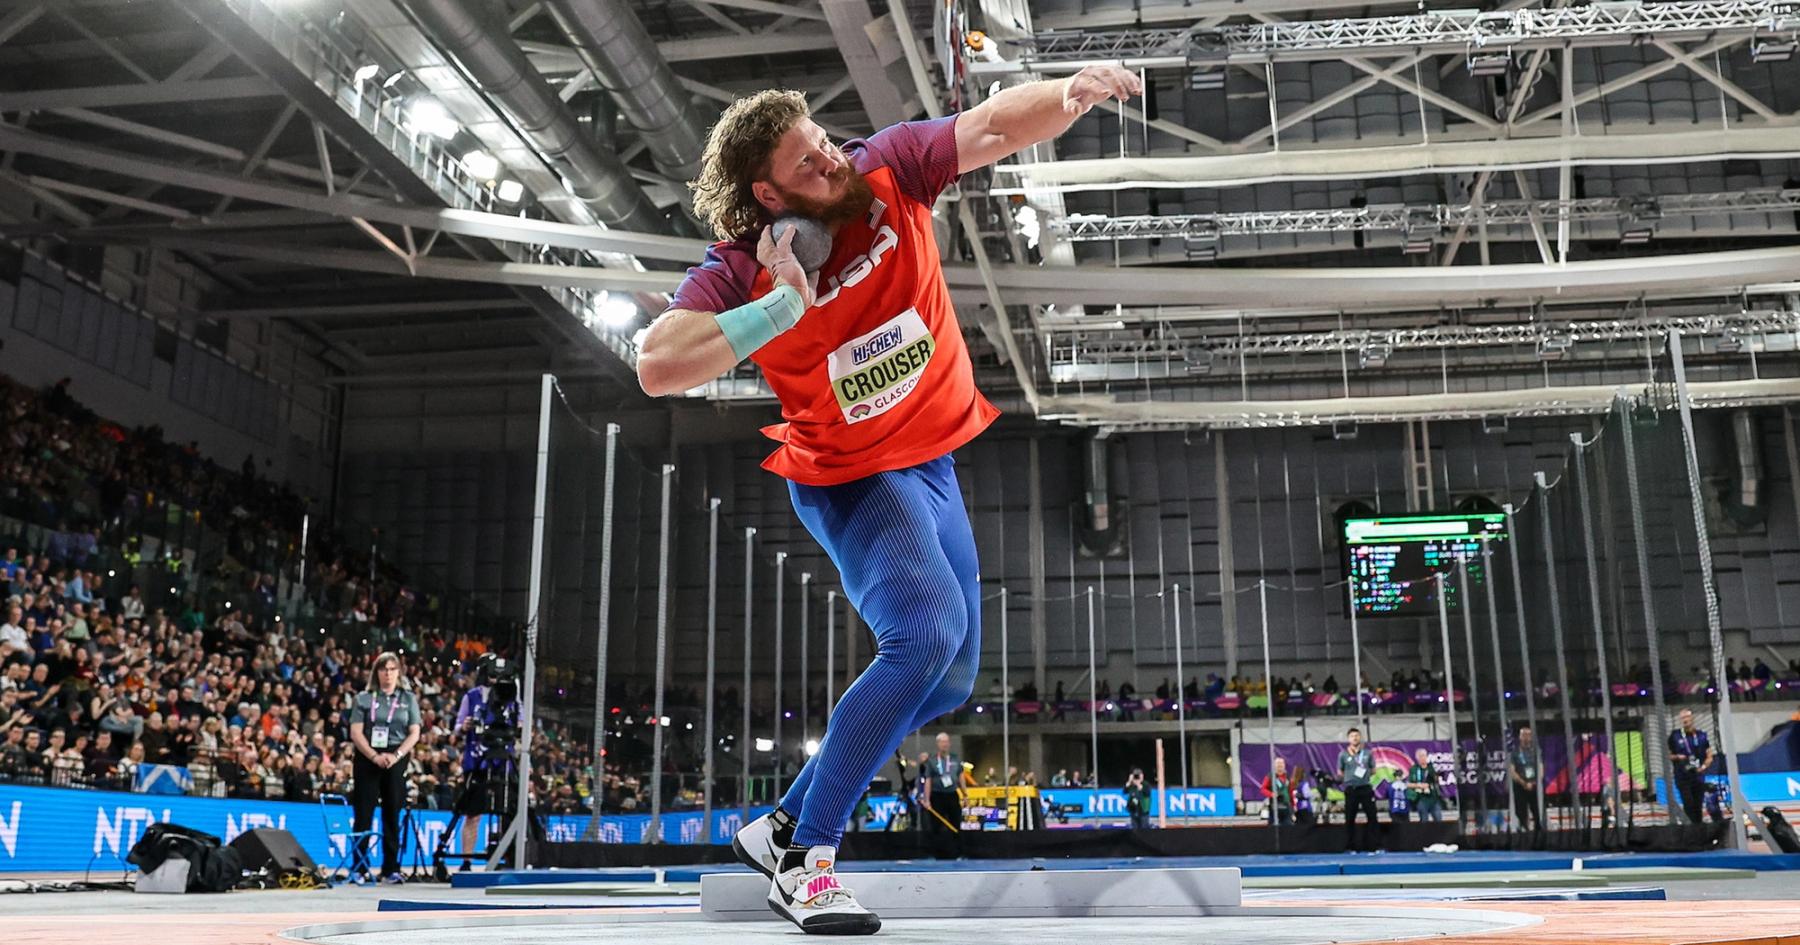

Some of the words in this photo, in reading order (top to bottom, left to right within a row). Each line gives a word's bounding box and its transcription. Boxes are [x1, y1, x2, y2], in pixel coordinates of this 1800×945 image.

[813, 225, 899, 307] USA
[851, 325, 902, 365] HI-CHEW
[841, 340, 931, 401] CROUSER
[1438, 770, 1505, 785] LASGOW
[1169, 793, 1217, 812] NTN
[807, 875, 842, 898] NIKE
